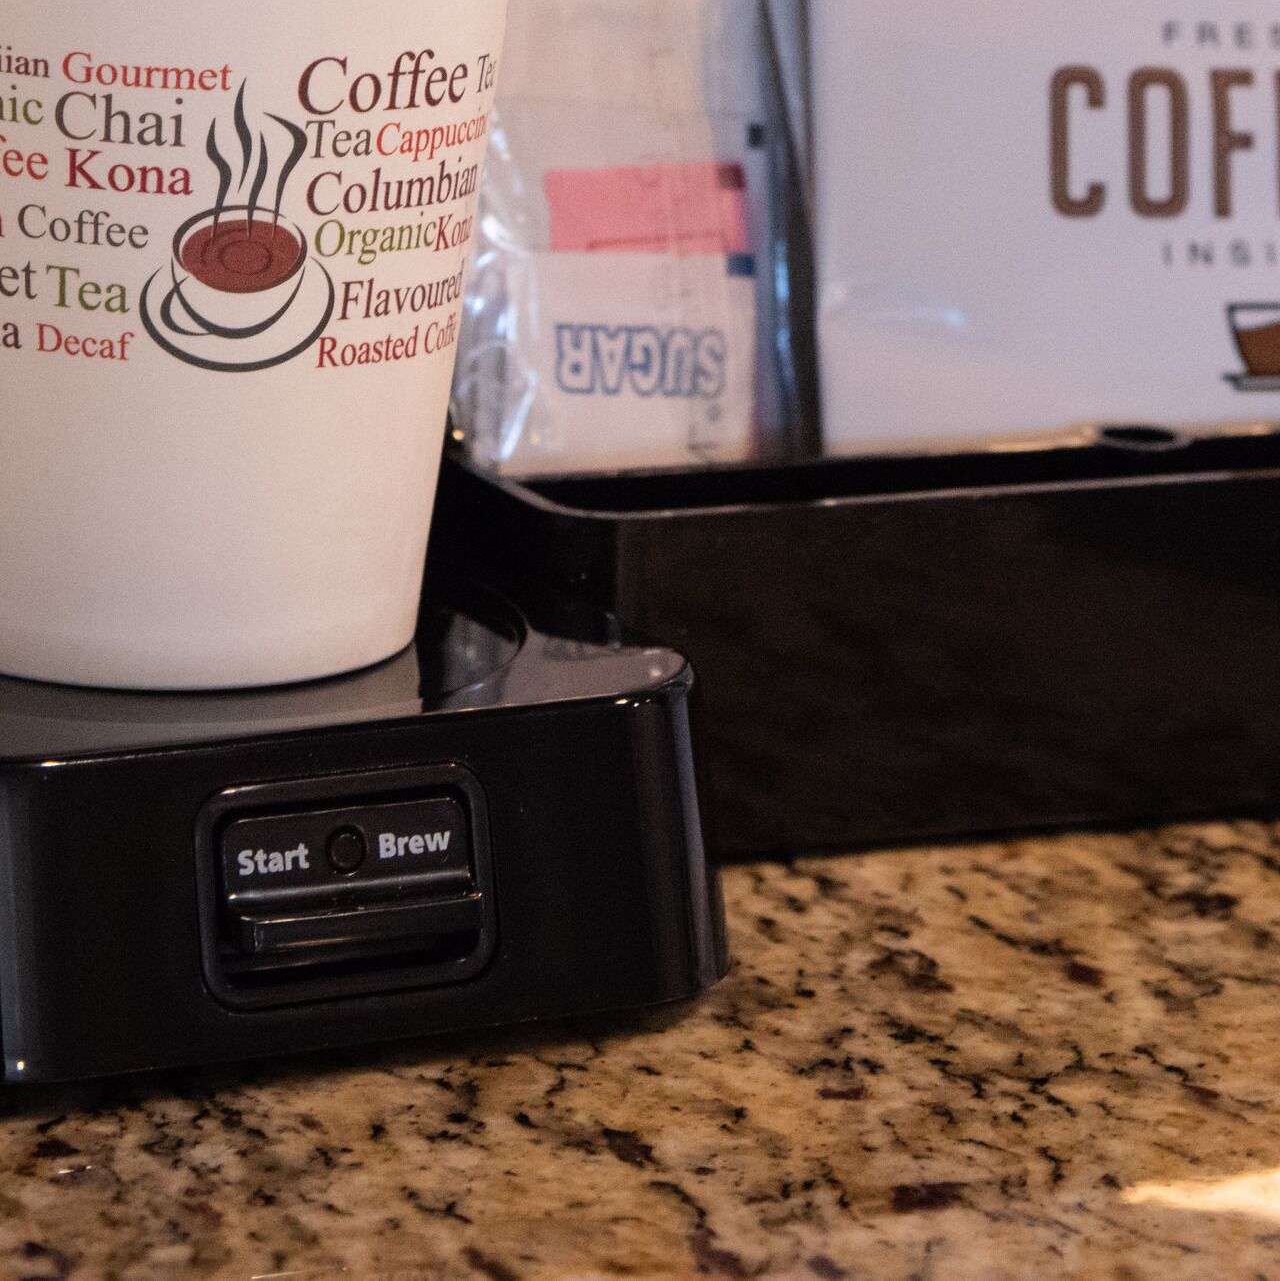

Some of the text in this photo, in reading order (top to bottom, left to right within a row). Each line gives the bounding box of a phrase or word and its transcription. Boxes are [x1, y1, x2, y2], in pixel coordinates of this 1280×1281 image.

[62, 51, 233, 91] Gourmet
[297, 48, 468, 116] Coffee
[54, 90, 186, 148] Chai
[305, 105, 489, 163] Tea Cappuccin
[64, 147, 194, 196] Kona
[306, 155, 479, 216] Columbian
[17, 204, 150, 249] Coffee
[314, 212, 437, 265] Organic
[46, 264, 131, 314] Tea
[337, 258, 465, 321] Flavoured
[35, 322, 135, 361] Decaf
[314, 325, 418, 369] Roasted
[555, 323, 727, 399] SUGAR
[237, 831, 451, 876] Start Brew
